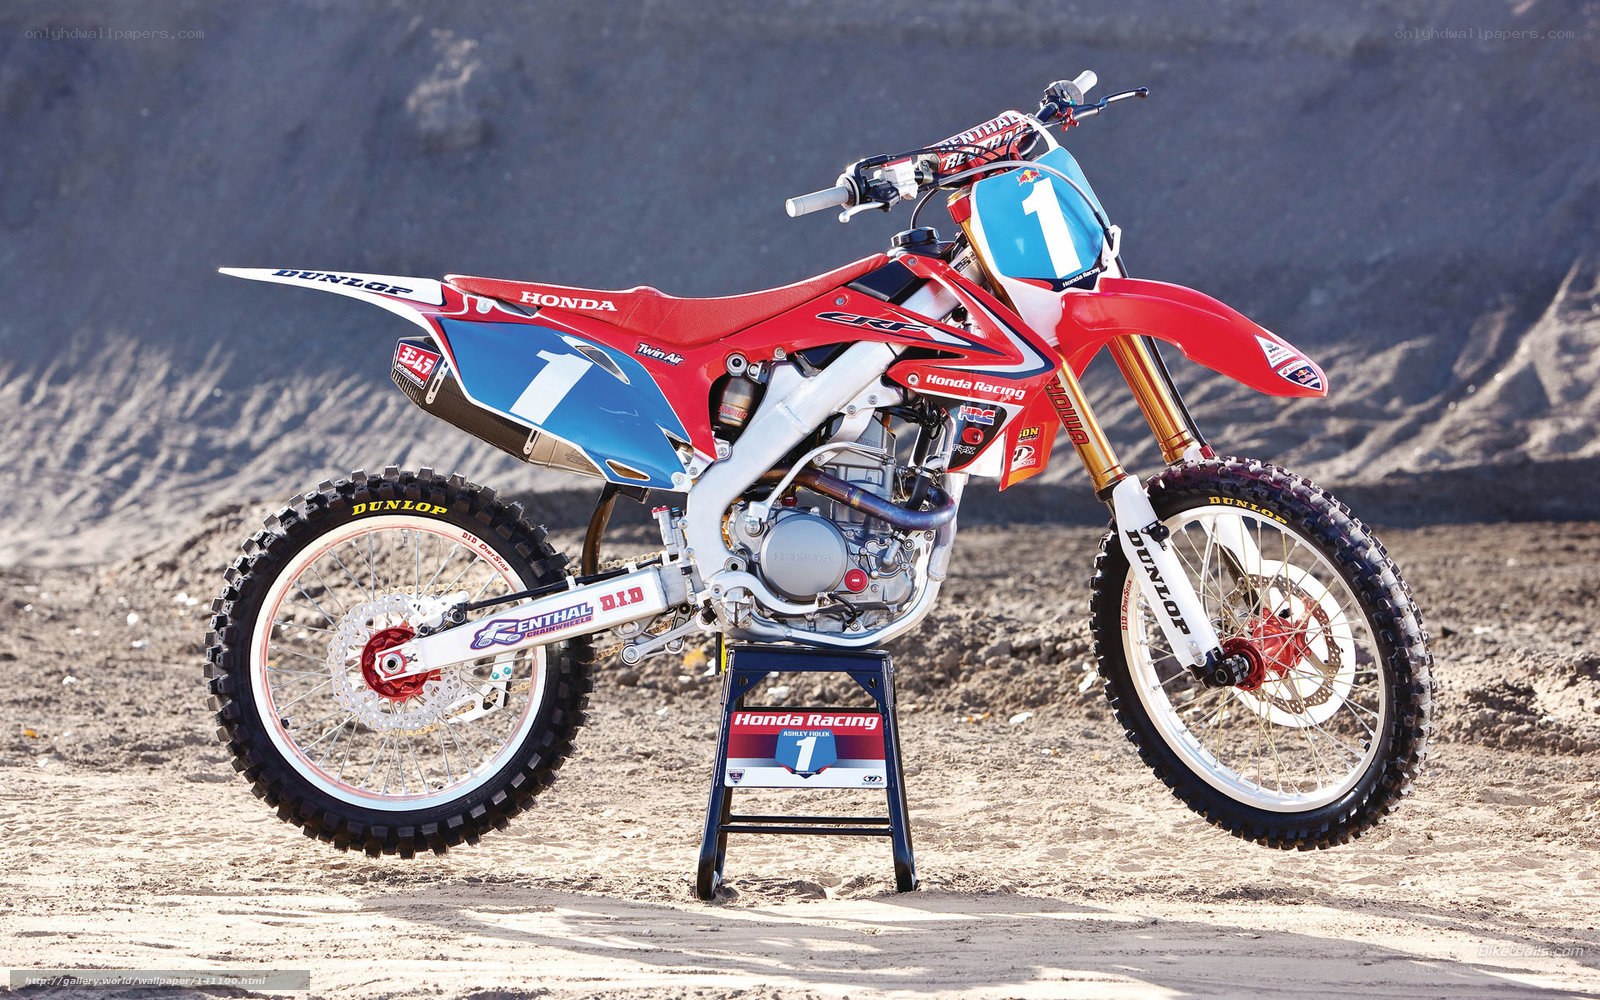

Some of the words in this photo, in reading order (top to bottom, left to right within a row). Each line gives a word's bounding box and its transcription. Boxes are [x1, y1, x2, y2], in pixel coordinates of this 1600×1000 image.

[1021, 177, 1082, 279] 1
[272, 269, 413, 295] DUNLOP
[1062, 274, 1083, 288] Honda
[519, 291, 617, 312] HONDA
[816, 311, 929, 332] CRF
[399, 346, 434, 375] ヨシムラ
[637, 342, 666, 360] Twin
[663, 352, 685, 364] Air
[509, 350, 594, 426] 1
[926, 374, 972, 391] Honda
[973, 381, 1026, 400] Racing
[352, 500, 448, 516] DUNLOP
[1208, 496, 1287, 525] DUNLOP
[462, 532, 478, 544] DID
[1125, 529, 1191, 635] DUNLOP
[472, 604, 592, 649] RENTHAL
[526, 616, 592, 637] CHAINWHEELS
[734, 713, 803, 726] Honda
[806, 714, 879, 730] Racing
[795, 737, 817, 771] 1
